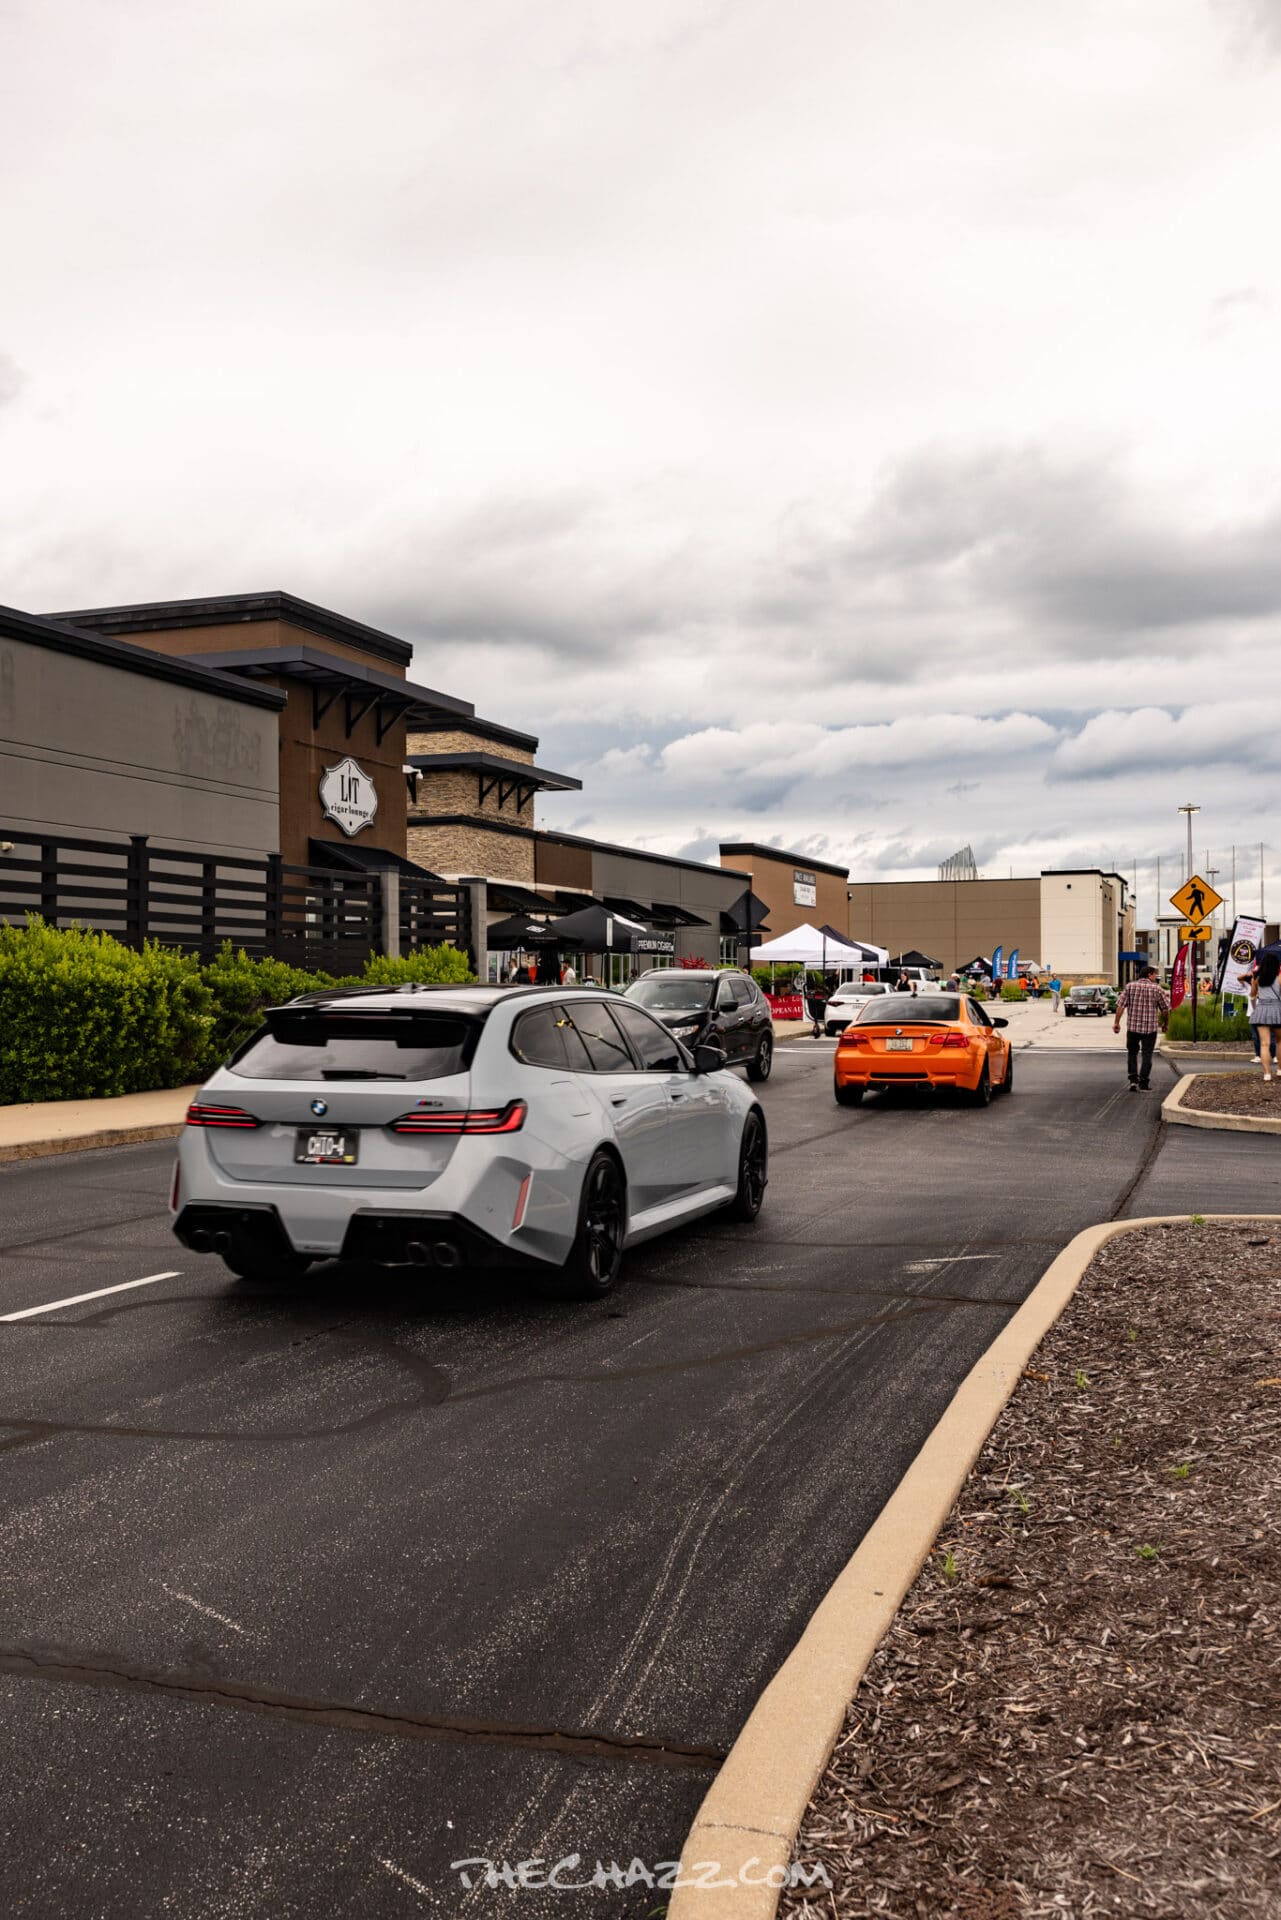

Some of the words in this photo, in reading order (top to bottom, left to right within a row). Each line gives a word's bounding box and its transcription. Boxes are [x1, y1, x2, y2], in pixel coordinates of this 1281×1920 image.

[340, 774, 359, 804] LIT
[331, 803, 348, 813] cigar
[349, 805, 369, 818] lounge
